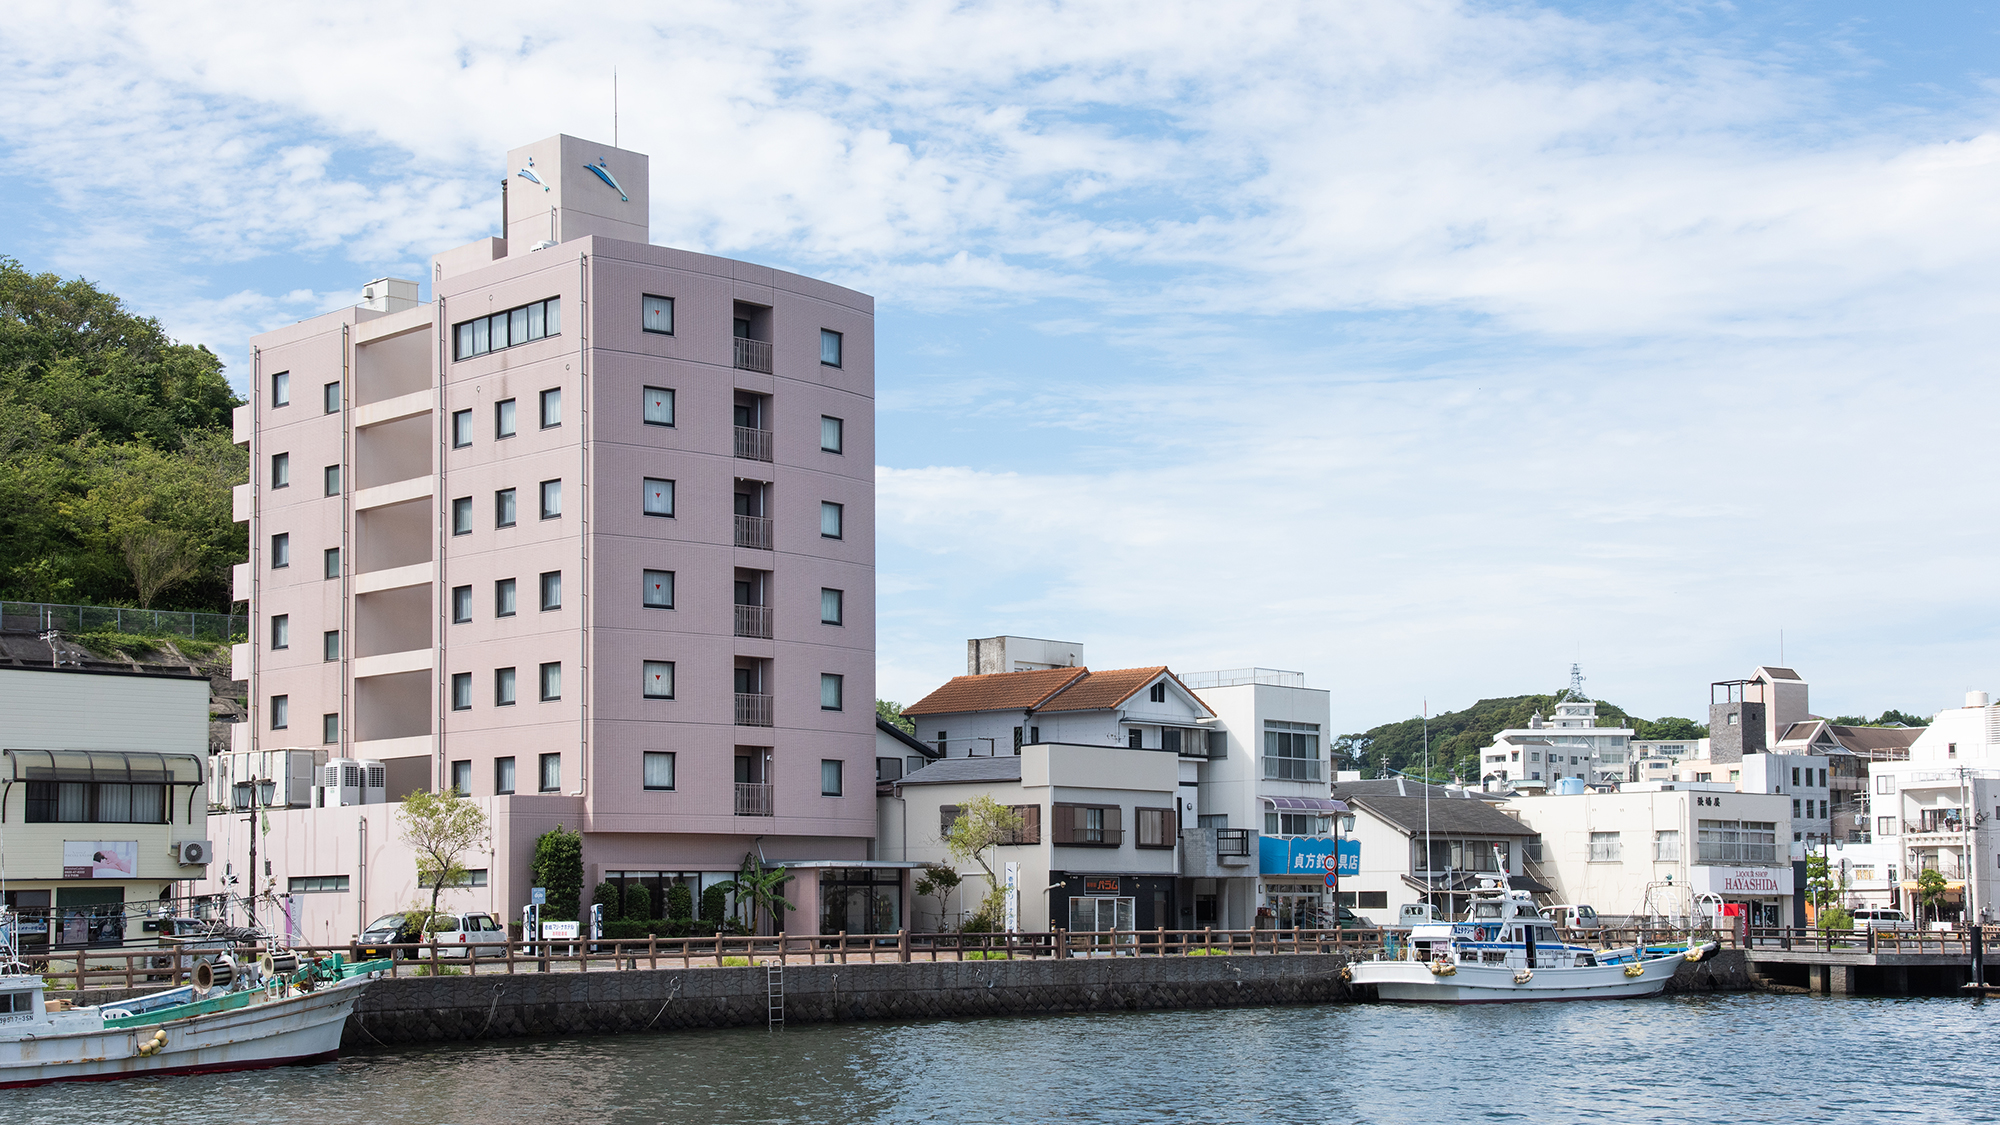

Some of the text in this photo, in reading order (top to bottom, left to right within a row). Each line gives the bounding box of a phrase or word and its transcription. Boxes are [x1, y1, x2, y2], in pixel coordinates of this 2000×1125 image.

[1294, 853, 1358, 869] 貞方釣具店
[1725, 878, 1778, 890] HAYASHIDA
